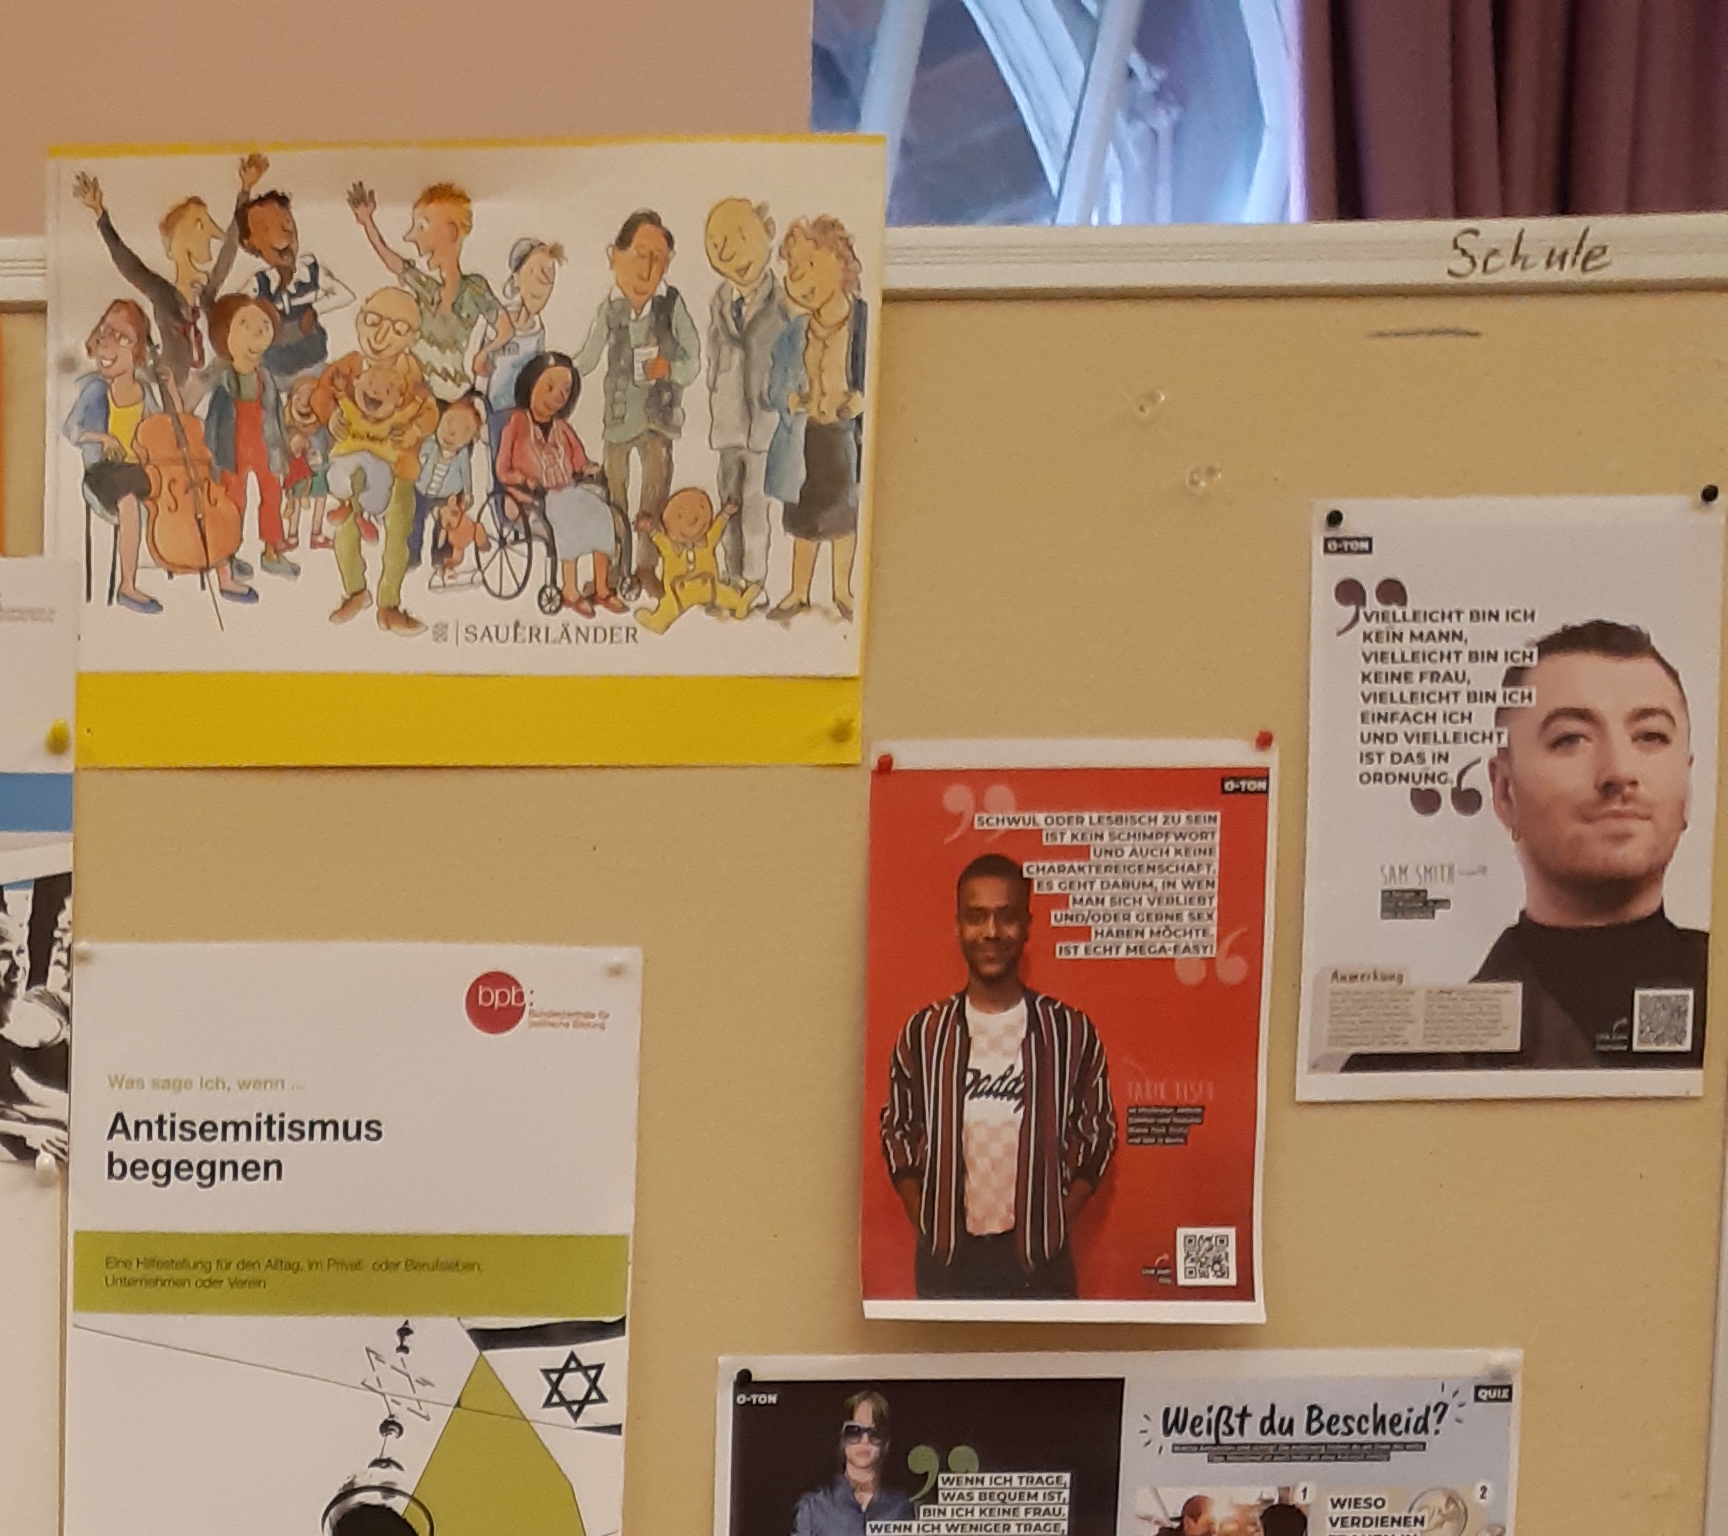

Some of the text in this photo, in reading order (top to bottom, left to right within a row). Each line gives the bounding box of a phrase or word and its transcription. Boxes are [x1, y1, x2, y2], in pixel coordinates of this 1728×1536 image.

[1447, 226, 1612, 278] Schule
[1327, 540, 1370, 551] O-TON
[1362, 610, 1535, 623] VIELLEICHT BIN ICH
[464, 620, 638, 644] SAUERLÄNDER
[1362, 631, 1468, 645] KEIN MANN,
[1225, 780, 1266, 791] O-TON
[108, 1074, 145, 1090] Was
[151, 1077, 193, 1093] sage
[236, 1078, 285, 1090] wenn
[106, 1111, 384, 1143] Antisemitismus
[106, 1151, 283, 1188] begegnen
[236, 1259, 260, 1271] den
[736, 1394, 778, 1404] O-TON
[1478, 1388, 1509, 1400] QUIZ
[1161, 1401, 1449, 1444] Weißt du Bescheid?
[941, 1475, 1067, 1488] WENN ICH TRAGE,
[941, 1492, 1066, 1503] WAS BEQUEM IST,
[1331, 1497, 1386, 1509] WIESO
[923, 1507, 1065, 1517] BIN ICH KEINE FRAU.
[1329, 1516, 1426, 1528] VERDIENEN
